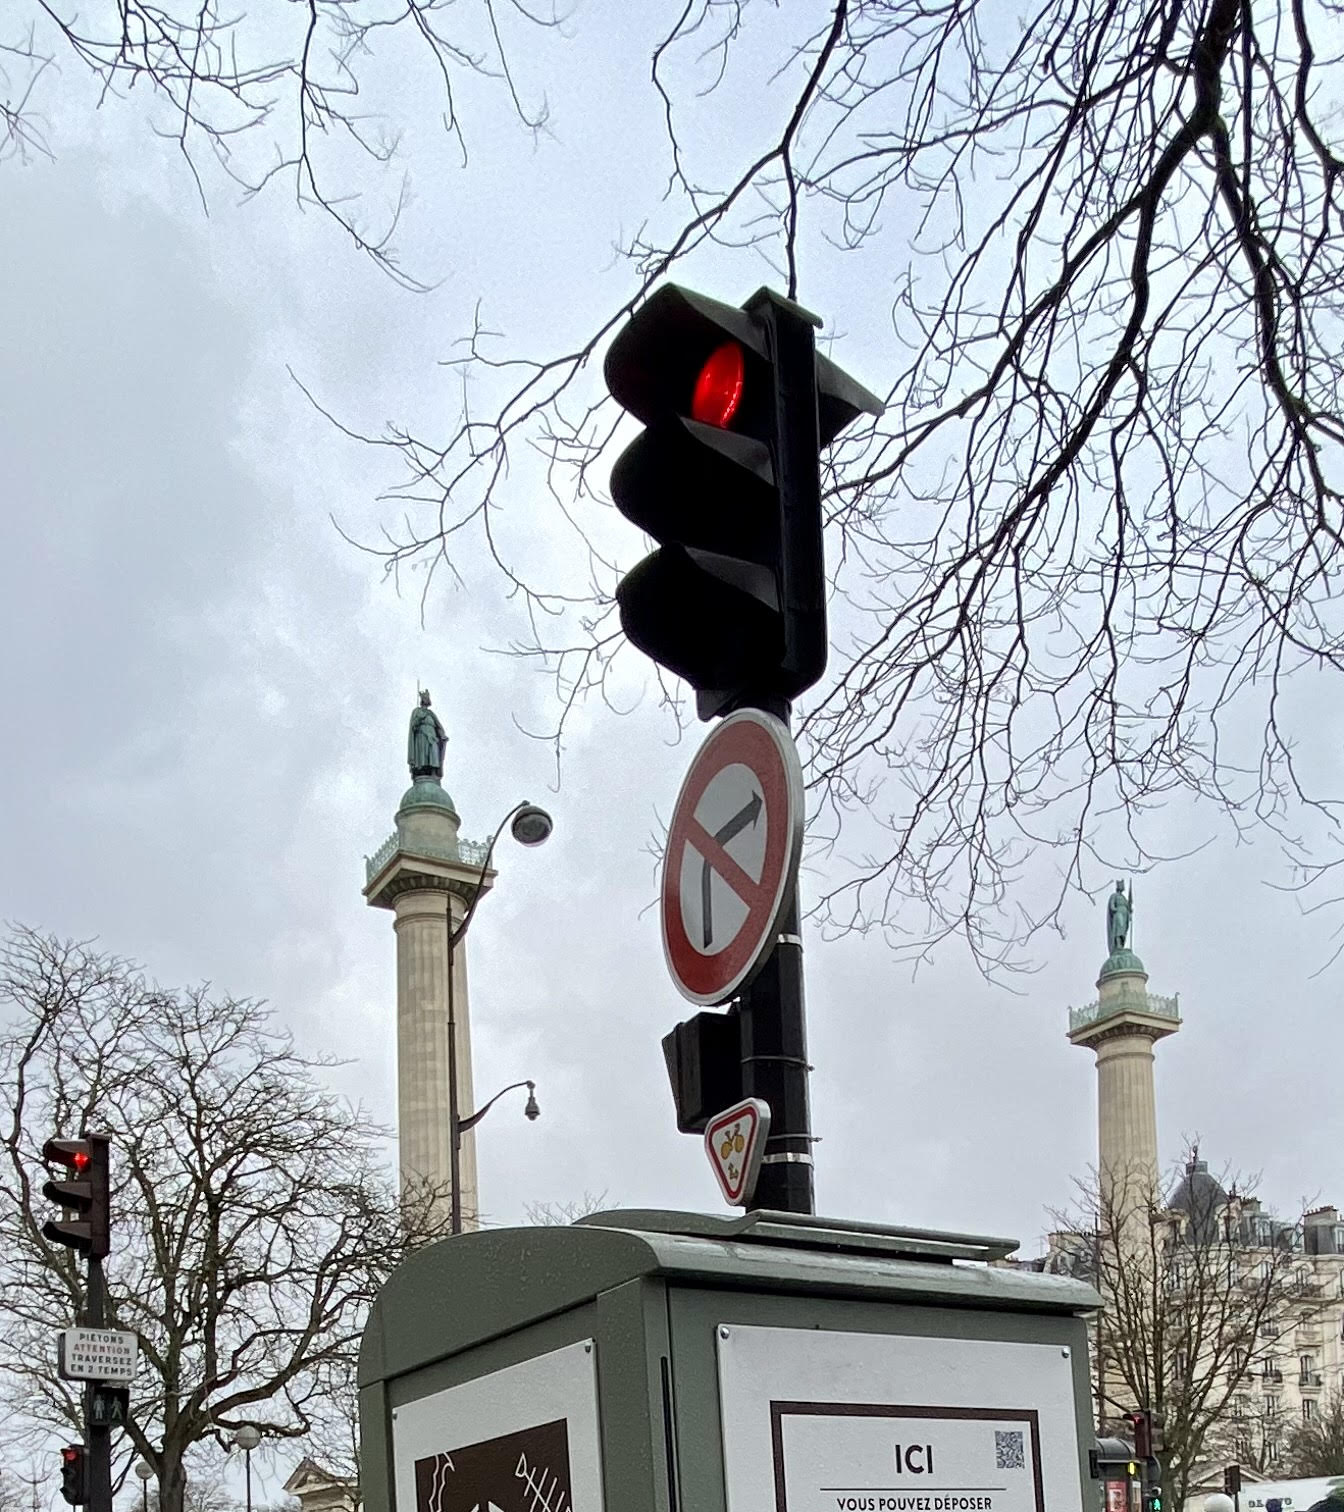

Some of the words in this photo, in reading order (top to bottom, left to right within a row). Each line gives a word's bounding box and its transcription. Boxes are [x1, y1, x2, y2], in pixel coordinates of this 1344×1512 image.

[74, 1343, 130, 1355] ATTENTION
[72, 1353, 132, 1365] TRAVERSEZ
[71, 1364, 84, 1372] EN
[88, 1365, 94, 1373] 2
[98, 1366, 132, 1376] TEMPS
[895, 1444, 934, 1474] ICI
[837, 1497, 875, 1511] VOUS
[879, 1497, 931, 1511] POUVEZ
[935, 1494, 992, 1510] DÉPOSER
